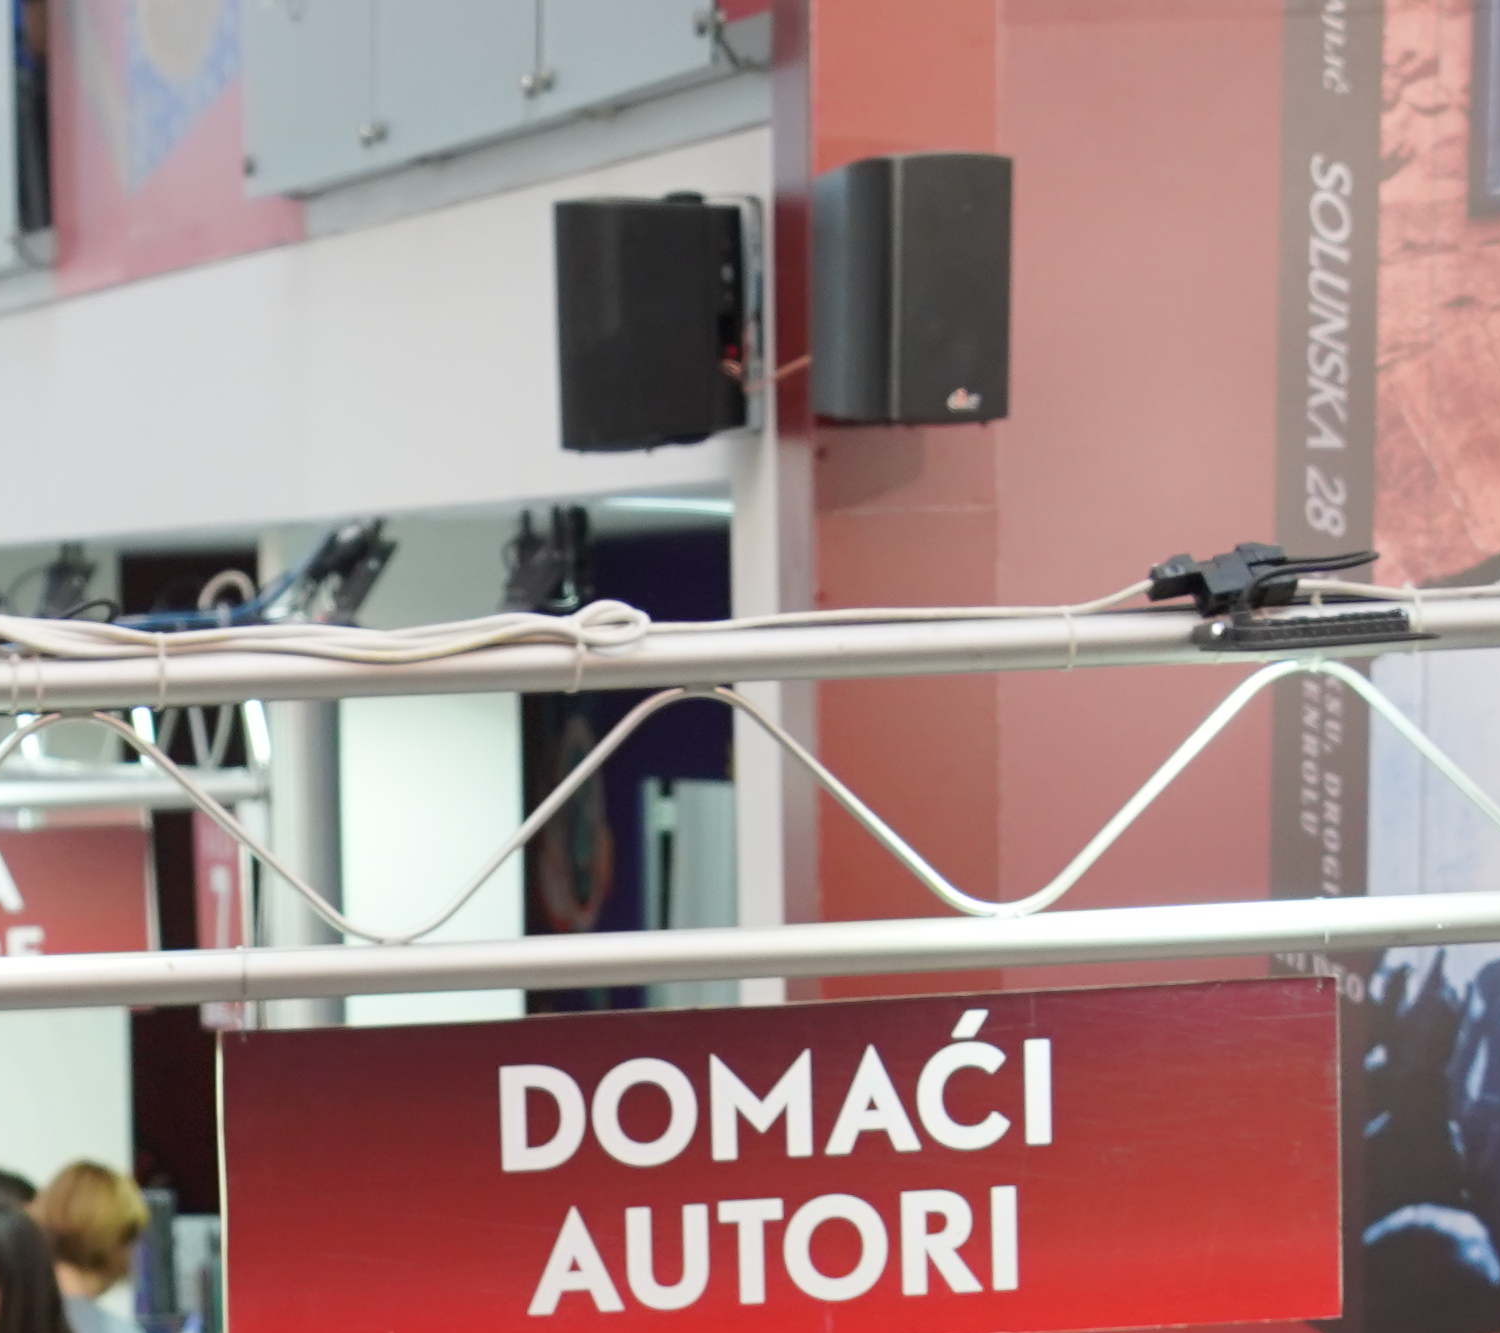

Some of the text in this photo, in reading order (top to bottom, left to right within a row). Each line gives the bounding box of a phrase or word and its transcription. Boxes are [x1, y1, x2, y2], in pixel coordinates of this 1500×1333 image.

[1304, 150, 1355, 538] SOLUNSKA 28
[1301, 680, 1321, 837] ENROLU
[498, 1009, 1052, 1173] DOMAĆI
[526, 1186, 1019, 1317] AUTORI
